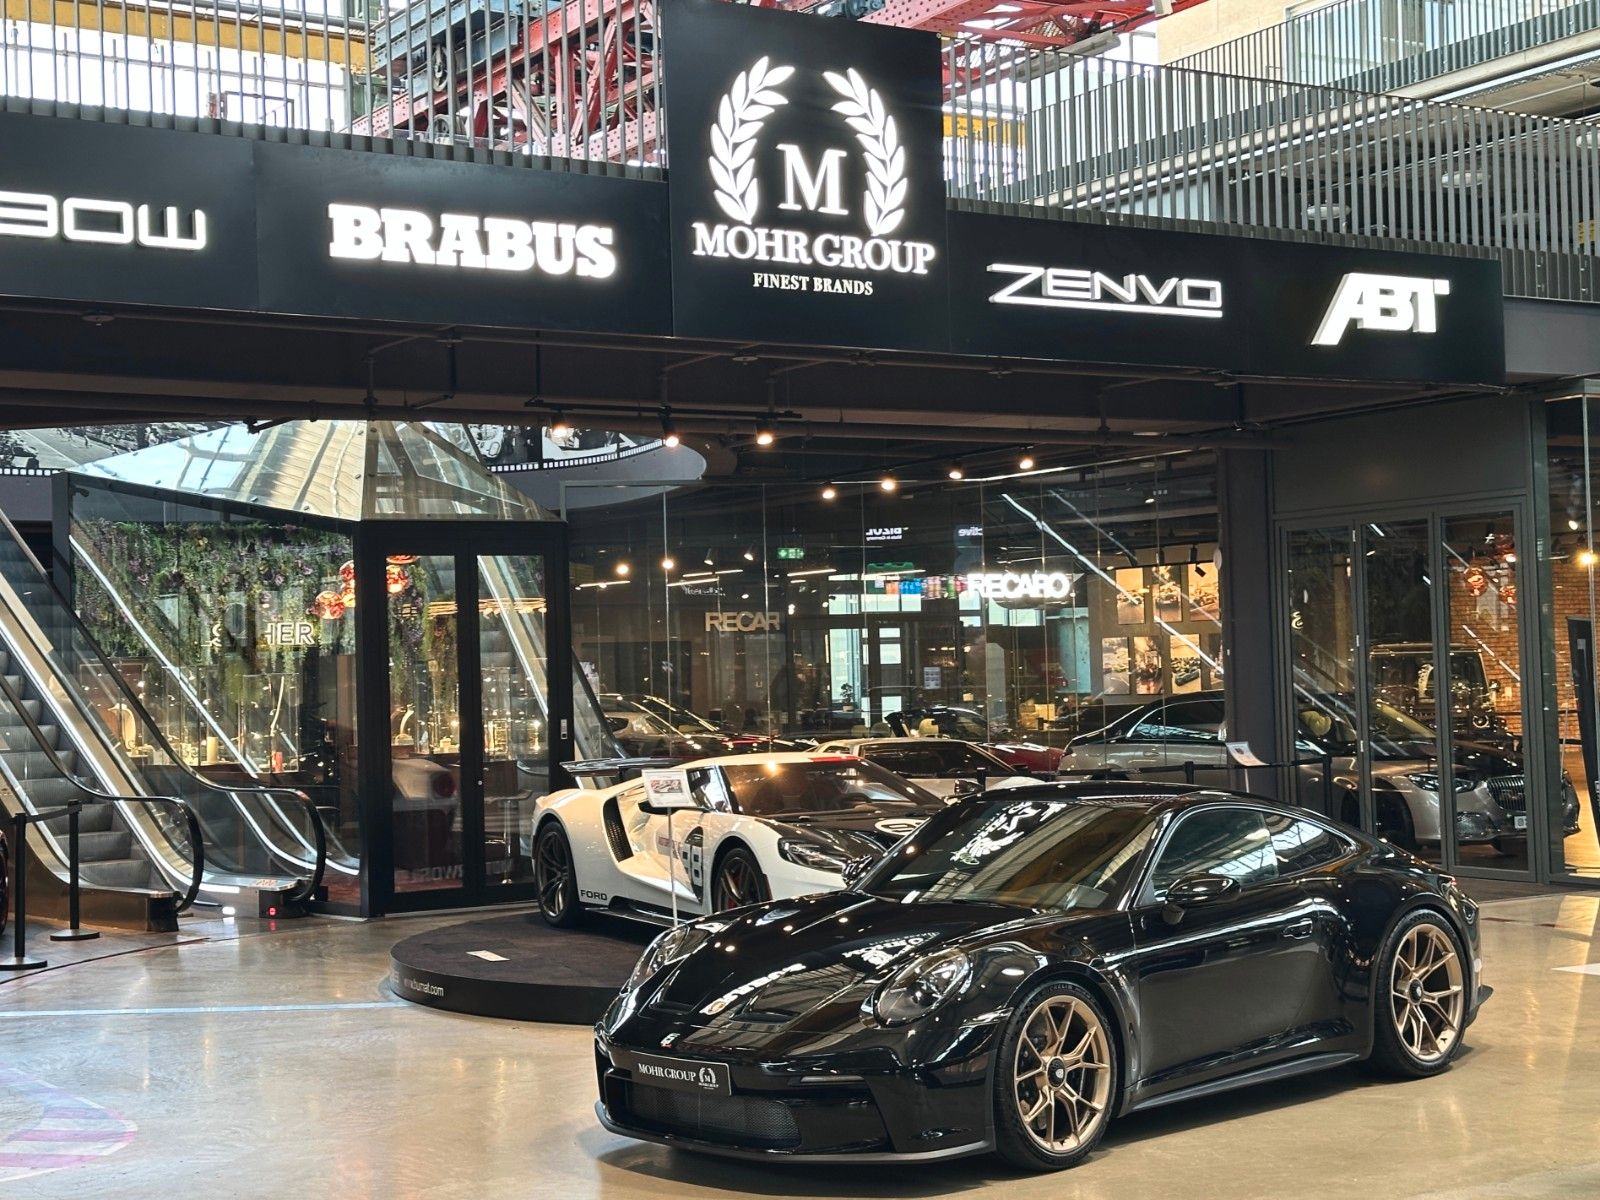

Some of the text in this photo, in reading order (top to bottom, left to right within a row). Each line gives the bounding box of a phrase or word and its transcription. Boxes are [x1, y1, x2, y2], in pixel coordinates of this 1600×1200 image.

[776, 143, 849, 215] M
[328, 203, 617, 279] BRABUS
[691, 222, 936, 275] MOHR GROUP
[752, 272, 874, 296] FINEST BRANDS
[986, 263, 1223, 318] ZENVO
[1311, 272, 1451, 346] ABT
[965, 572, 1071, 600] RECARO
[705, 611, 780, 632] RECAR
[580, 889, 608, 901] FORD
[638, 1063, 696, 1081] MOHR GROUP
